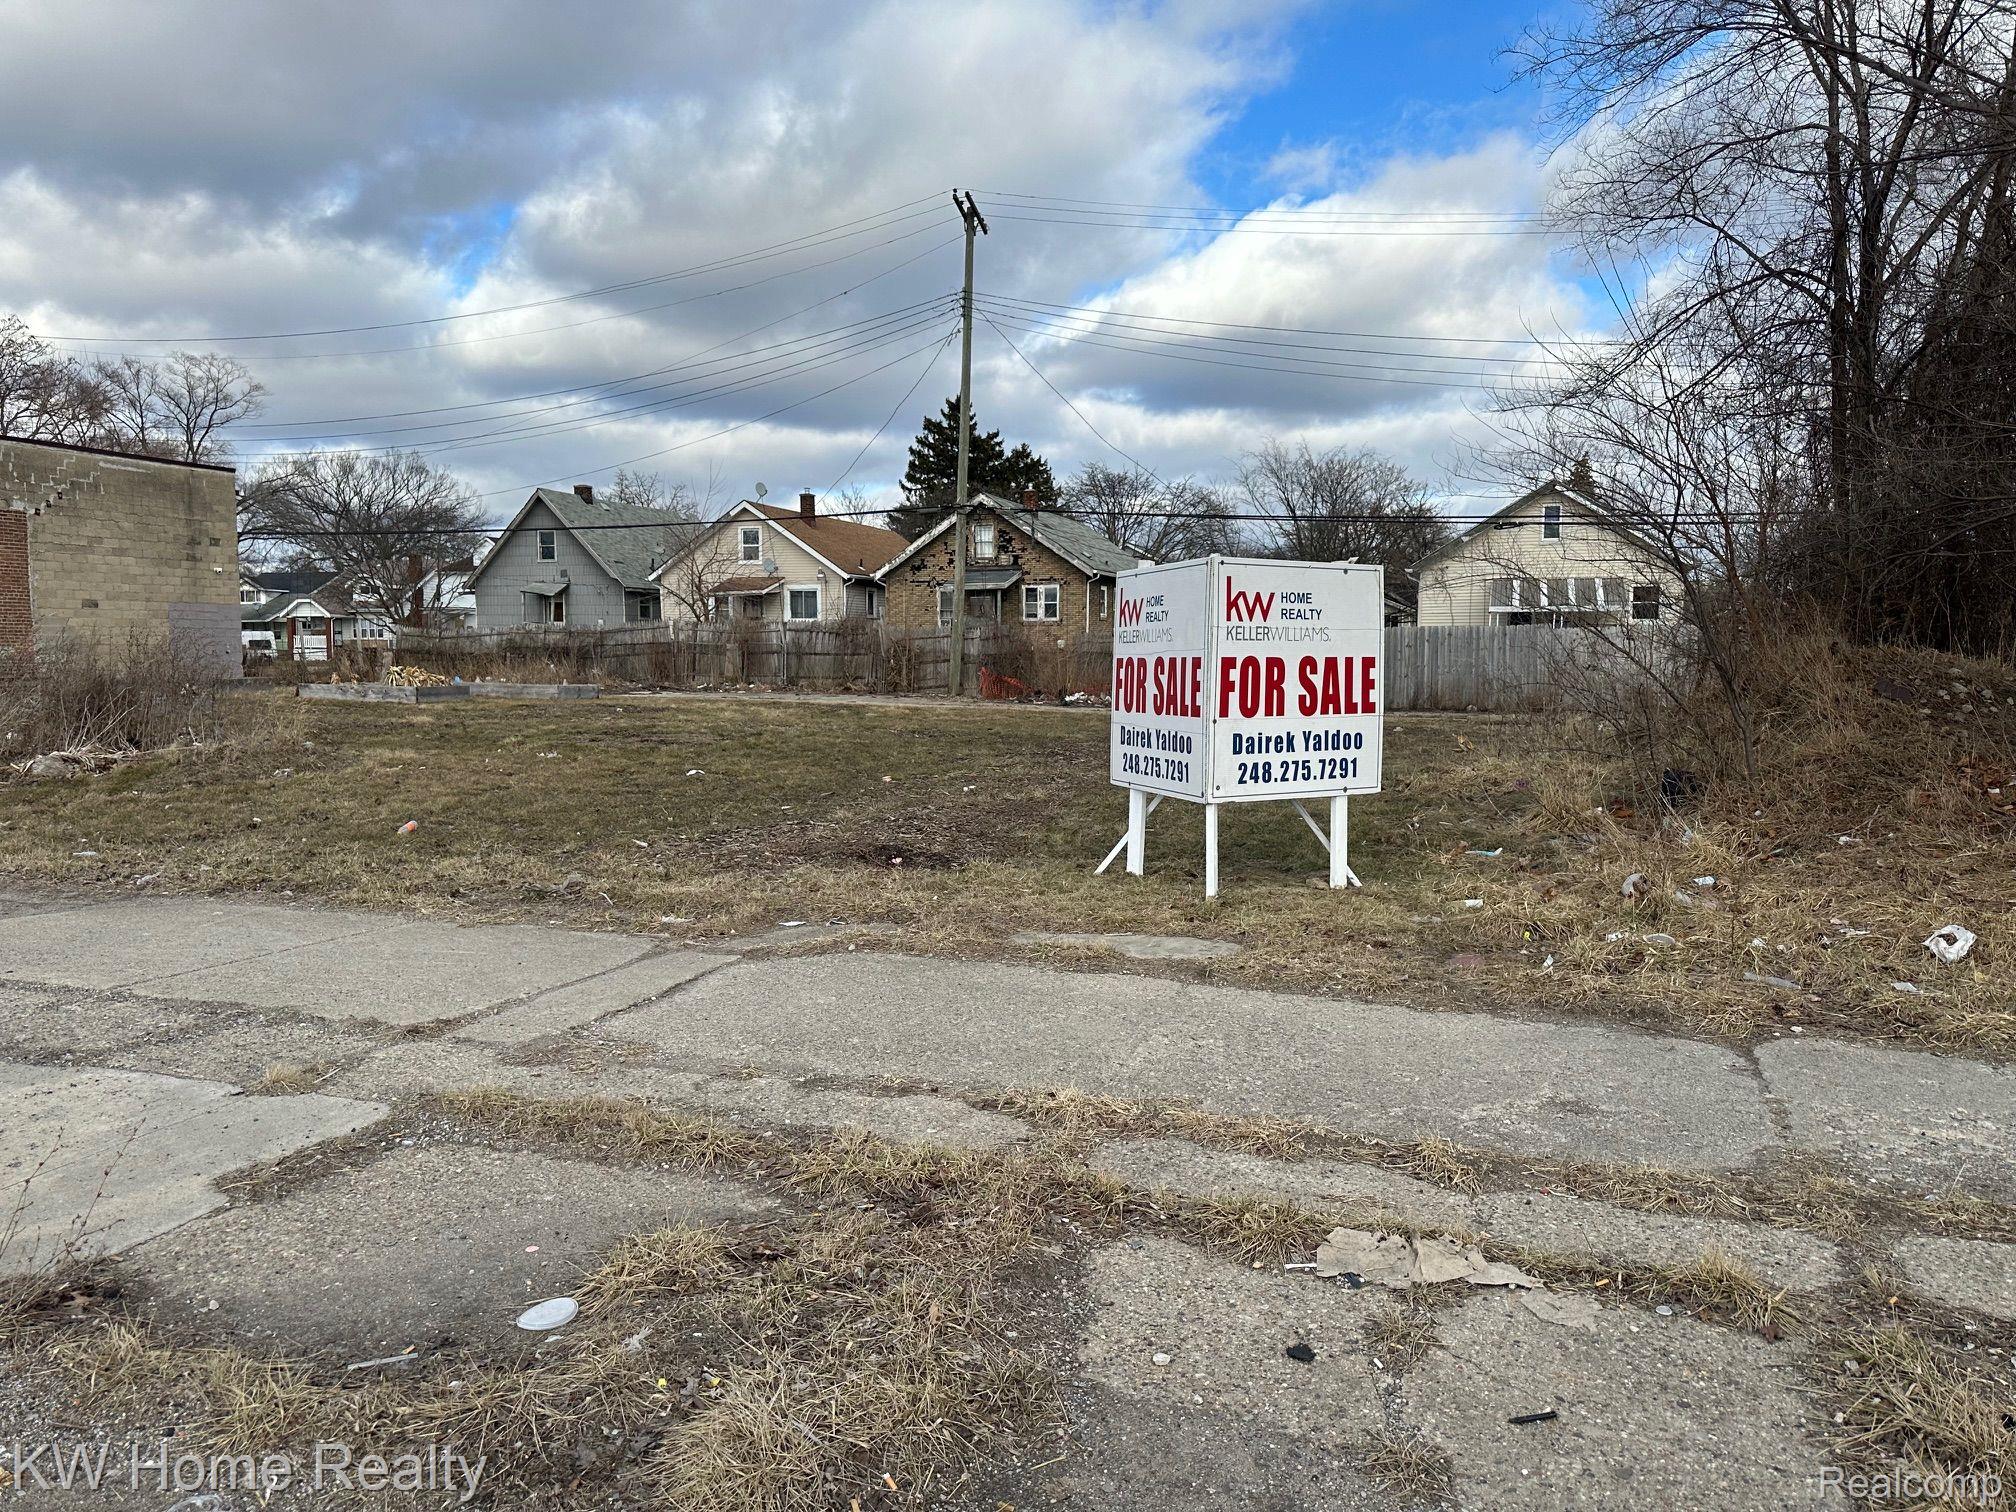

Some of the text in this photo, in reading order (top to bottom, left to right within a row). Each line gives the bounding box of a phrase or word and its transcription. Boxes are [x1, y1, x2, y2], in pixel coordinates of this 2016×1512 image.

[1119, 587, 1144, 628] kw
[1146, 594, 1164, 608] HOME
[1226, 575, 1275, 623] kw
[1281, 592, 1312, 604] HOME
[1145, 610, 1169, 622] REALTY
[1281, 608, 1322, 621] REALTY
[1115, 655, 1201, 718] FOR SALE
[1218, 655, 1376, 719] FOR SALE
[1120, 725, 1192, 755] Dairek Yaldoo
[1232, 729, 1363, 755] Dairek Yaldoo
[1122, 753, 1190, 784] 248.275.7291
[1237, 757, 1358, 785] 248.275.7291
